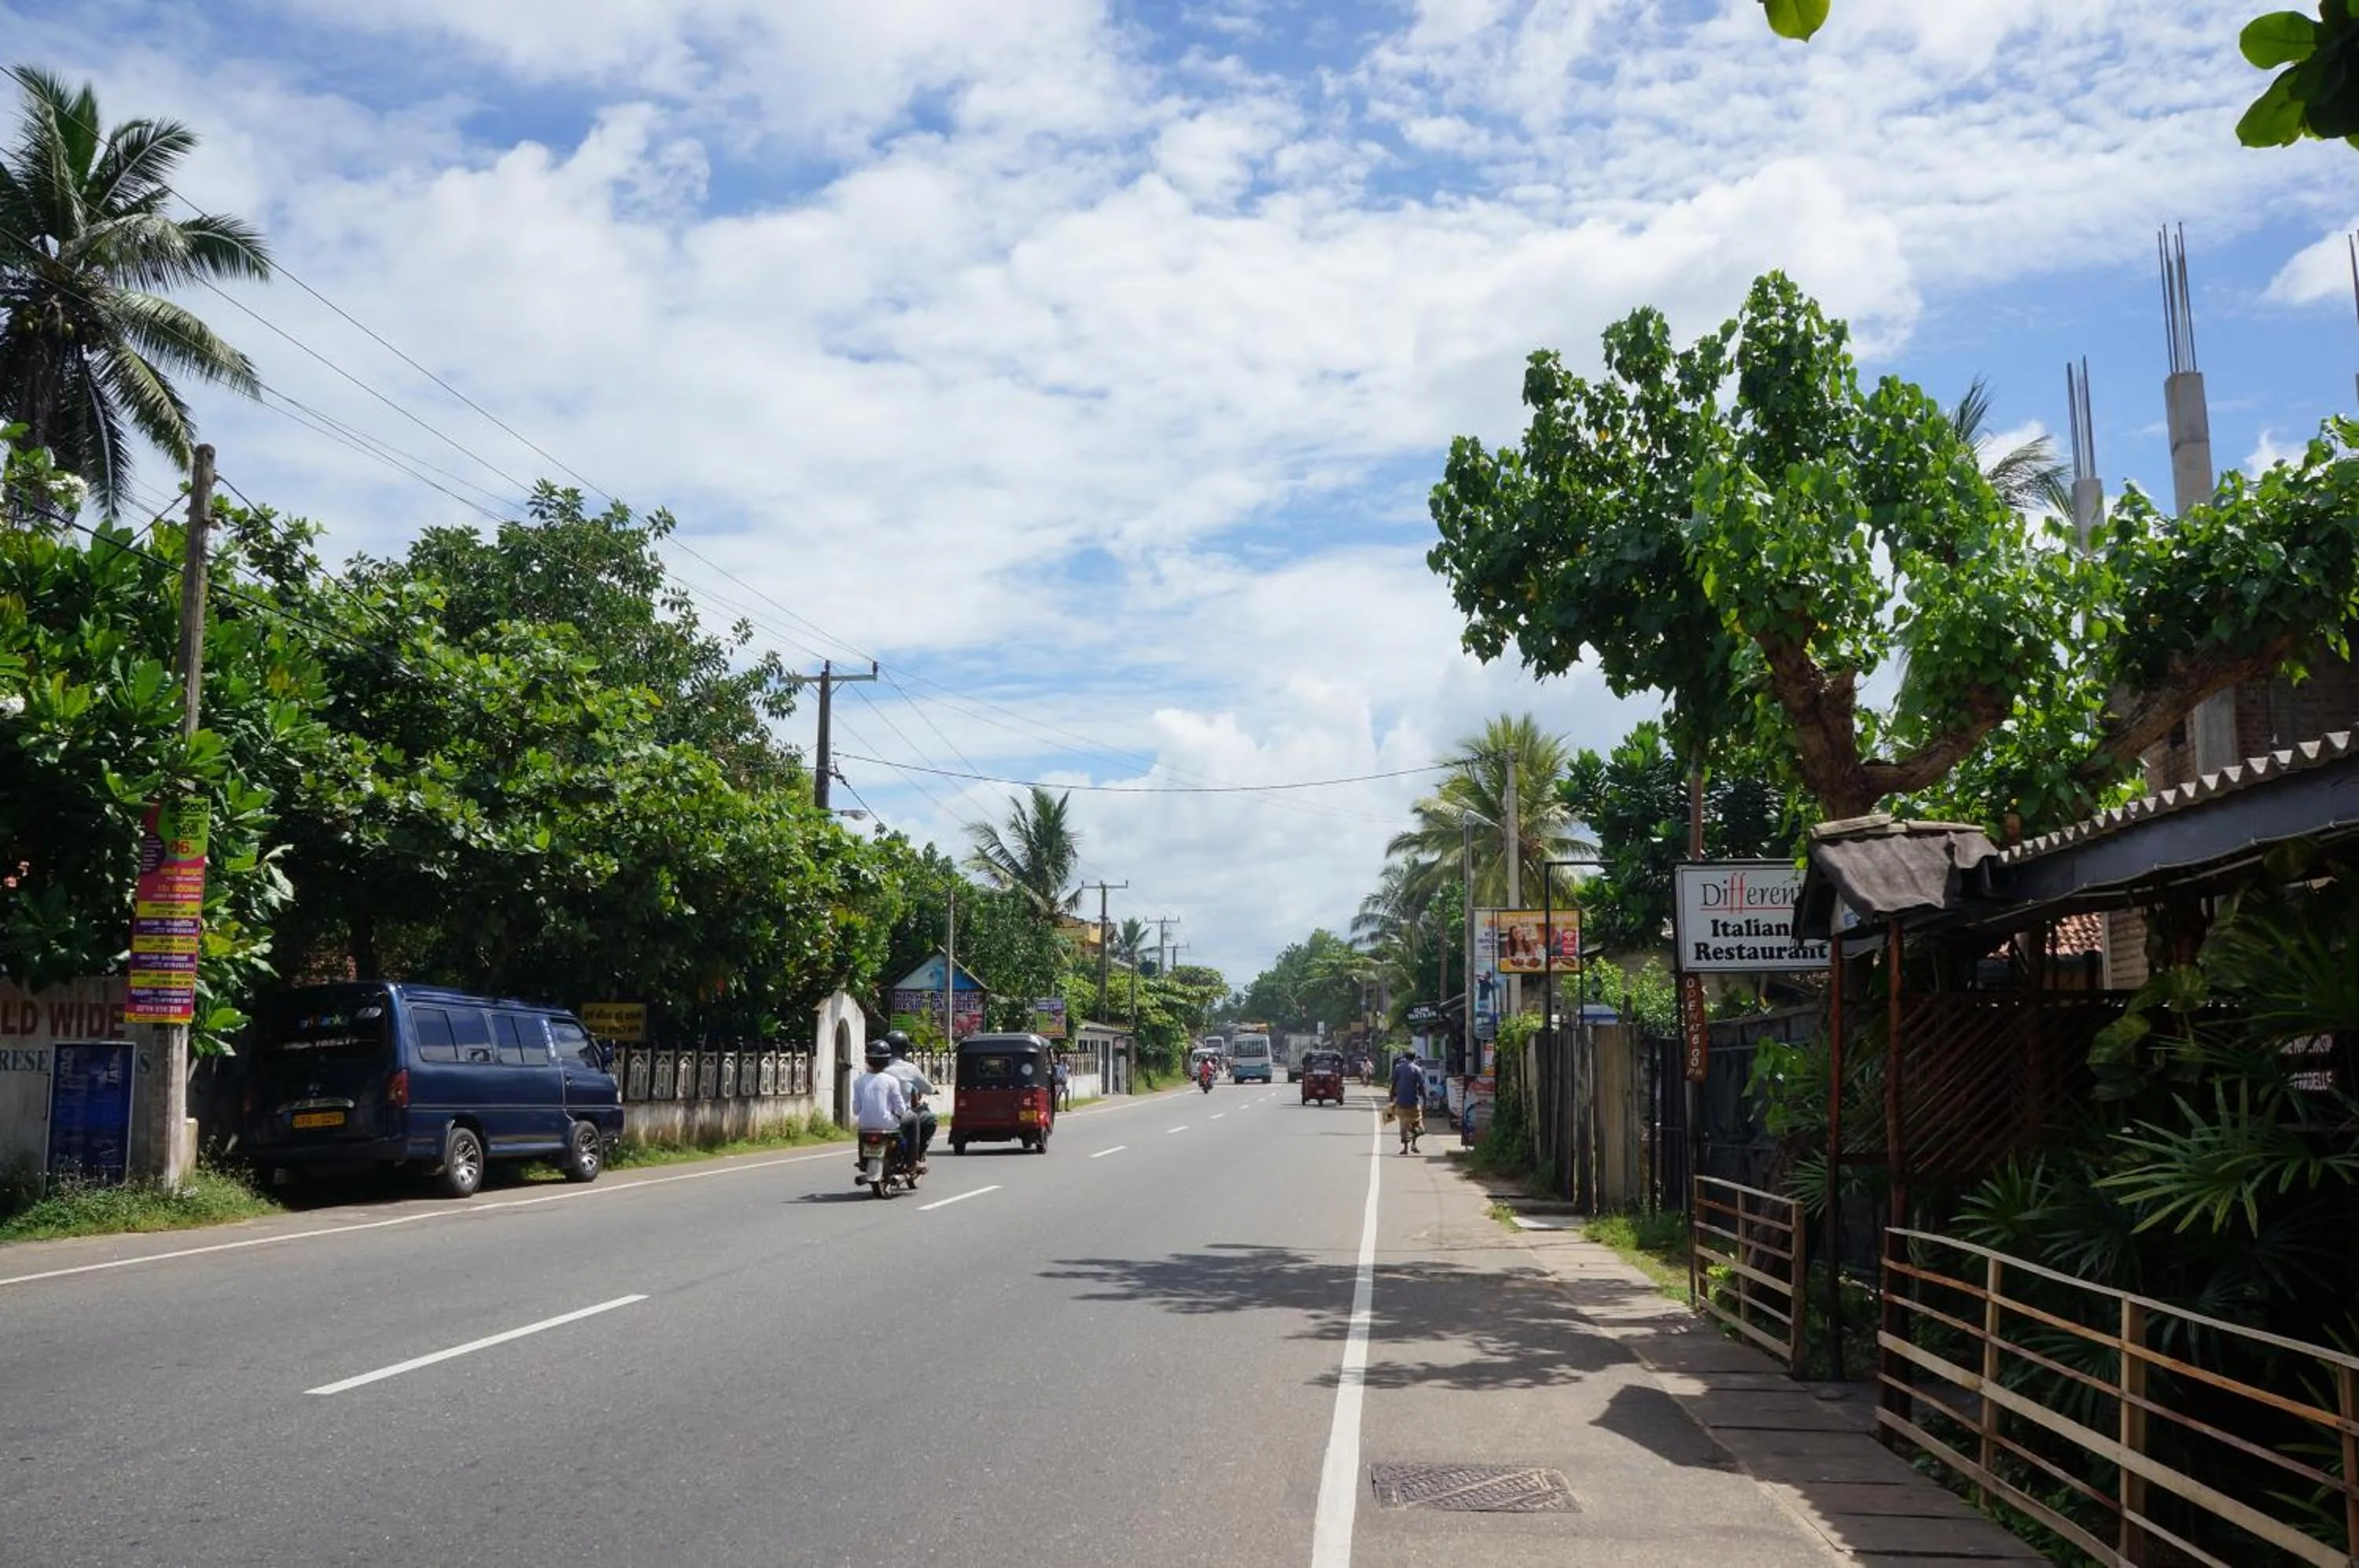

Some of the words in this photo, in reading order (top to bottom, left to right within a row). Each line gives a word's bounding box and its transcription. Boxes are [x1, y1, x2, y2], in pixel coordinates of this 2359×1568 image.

[1710, 918, 1789, 938] Italian
[1695, 941, 1827, 961] Restaurant
[1685, 977, 1698, 1020] OPEN
[48, 1002, 126, 1040] WIDE
